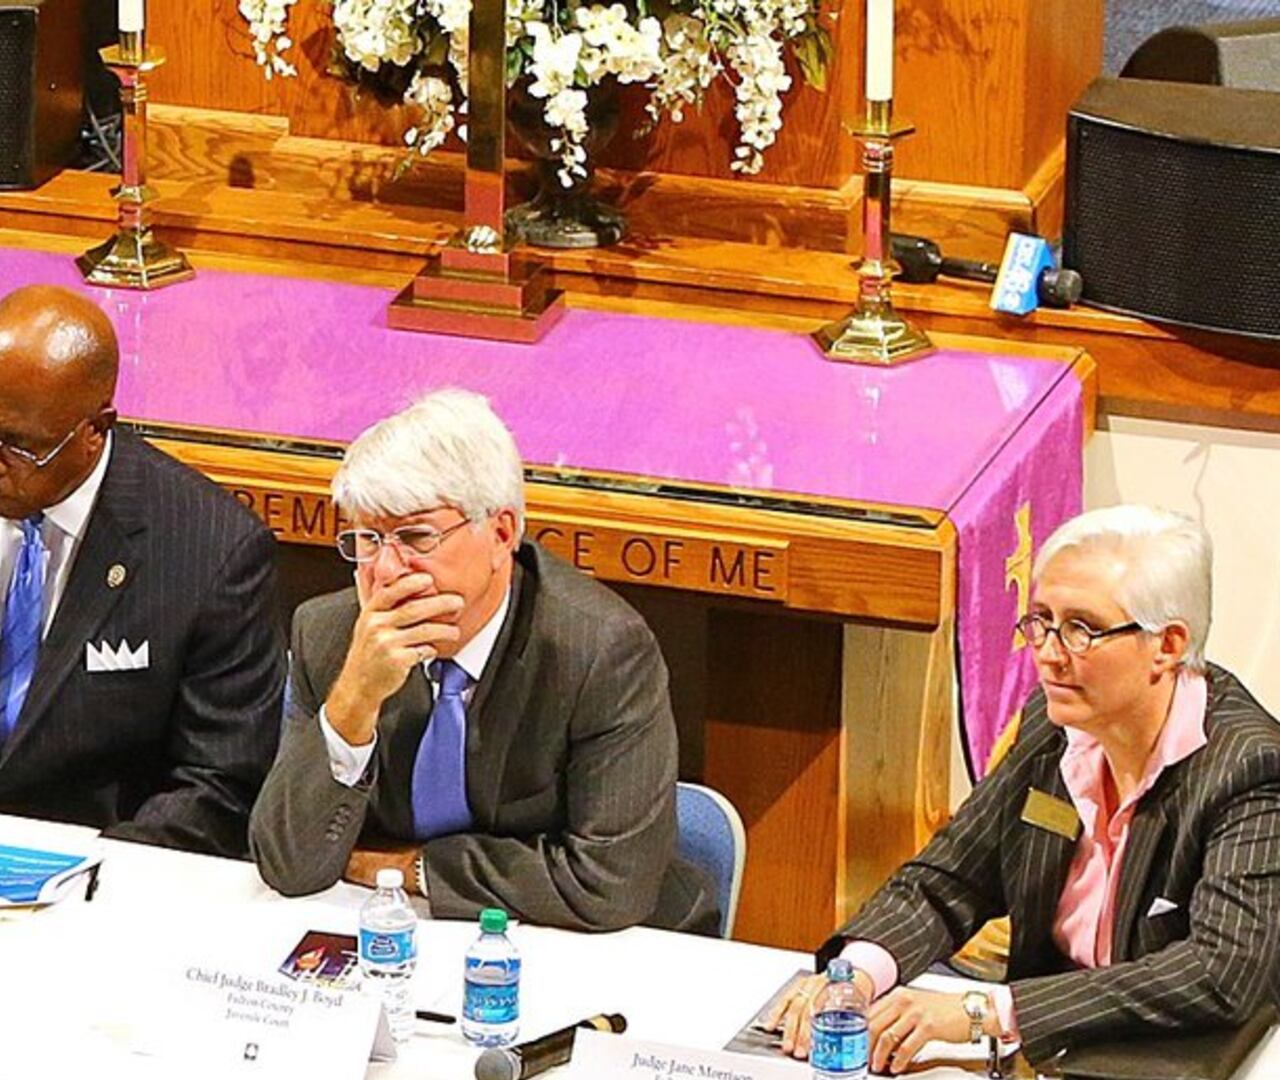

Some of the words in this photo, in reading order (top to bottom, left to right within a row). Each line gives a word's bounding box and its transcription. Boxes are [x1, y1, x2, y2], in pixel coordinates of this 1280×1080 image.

[620, 537, 684, 579] OF
[709, 546, 776, 592] ME
[186, 968, 219, 984] Chief
[220, 973, 254, 991] Judge
[257, 981, 299, 1001] Bradley
[313, 994, 344, 1008] Boyd
[227, 993, 260, 1007] Fulton
[261, 1001, 294, 1015] County
[226, 1008, 261, 1023] Juvenile
[263, 1015, 290, 1027] Court
[631, 1053, 668, 1071] Judge
[668, 1060, 695, 1076] Jane
